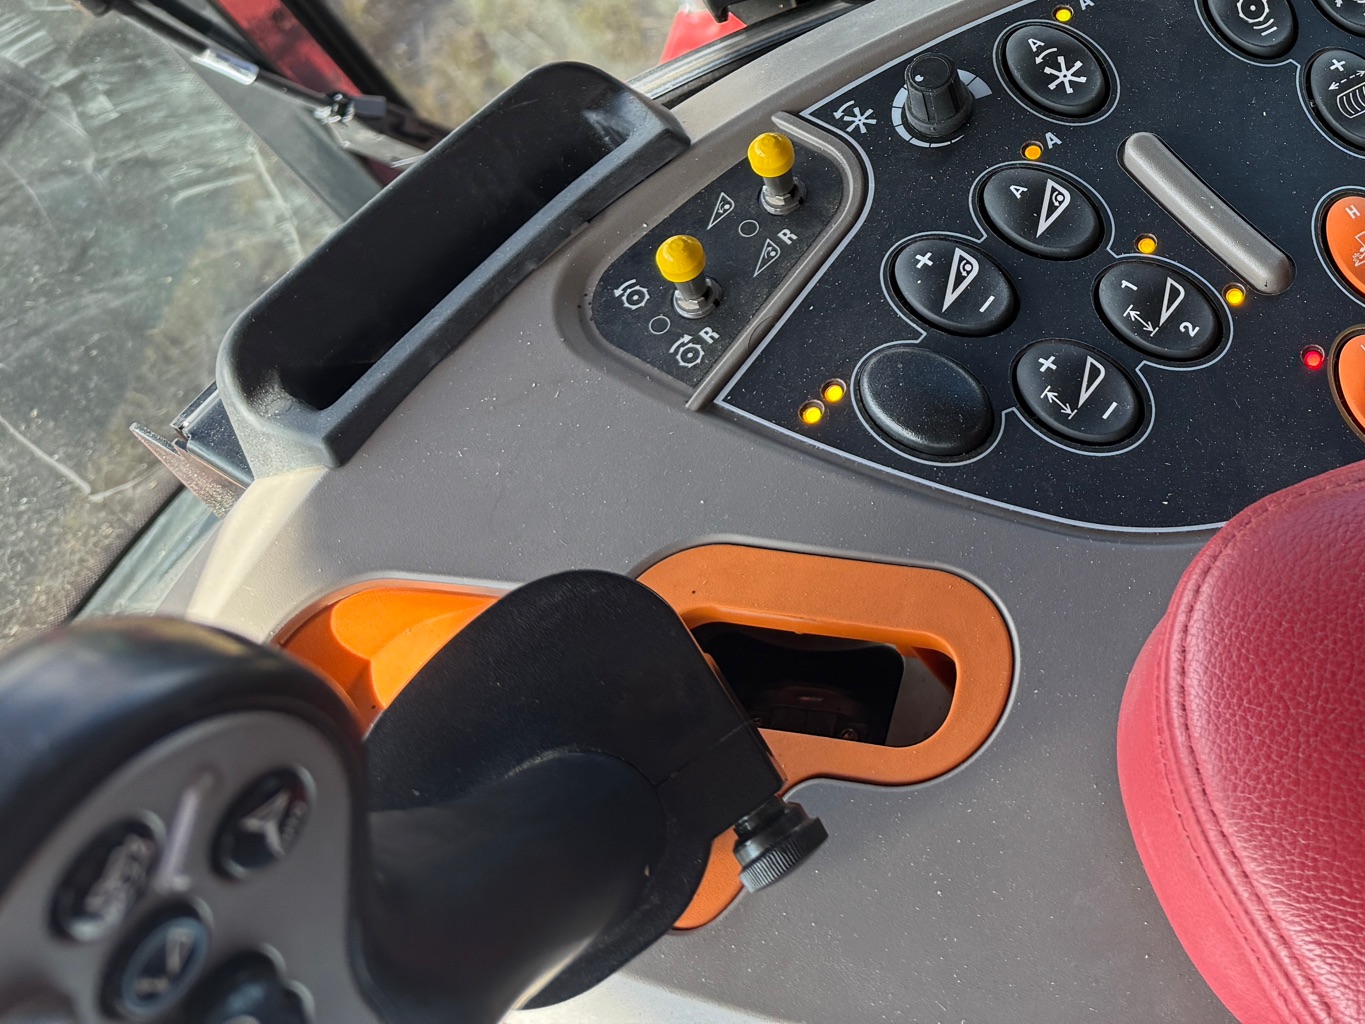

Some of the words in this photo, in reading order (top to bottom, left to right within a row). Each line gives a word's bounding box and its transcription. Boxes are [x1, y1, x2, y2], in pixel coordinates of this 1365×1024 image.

[1027, 37, 1045, 53] A
[1044, 131, 1062, 149] A
[1009, 183, 1028, 199] A
[1345, 204, 1361, 220] H
[777, 228, 798, 245] R
[1121, 279, 1138, 291] 1
[698, 326, 720, 344] R
[1180, 321, 1200, 337] 2
